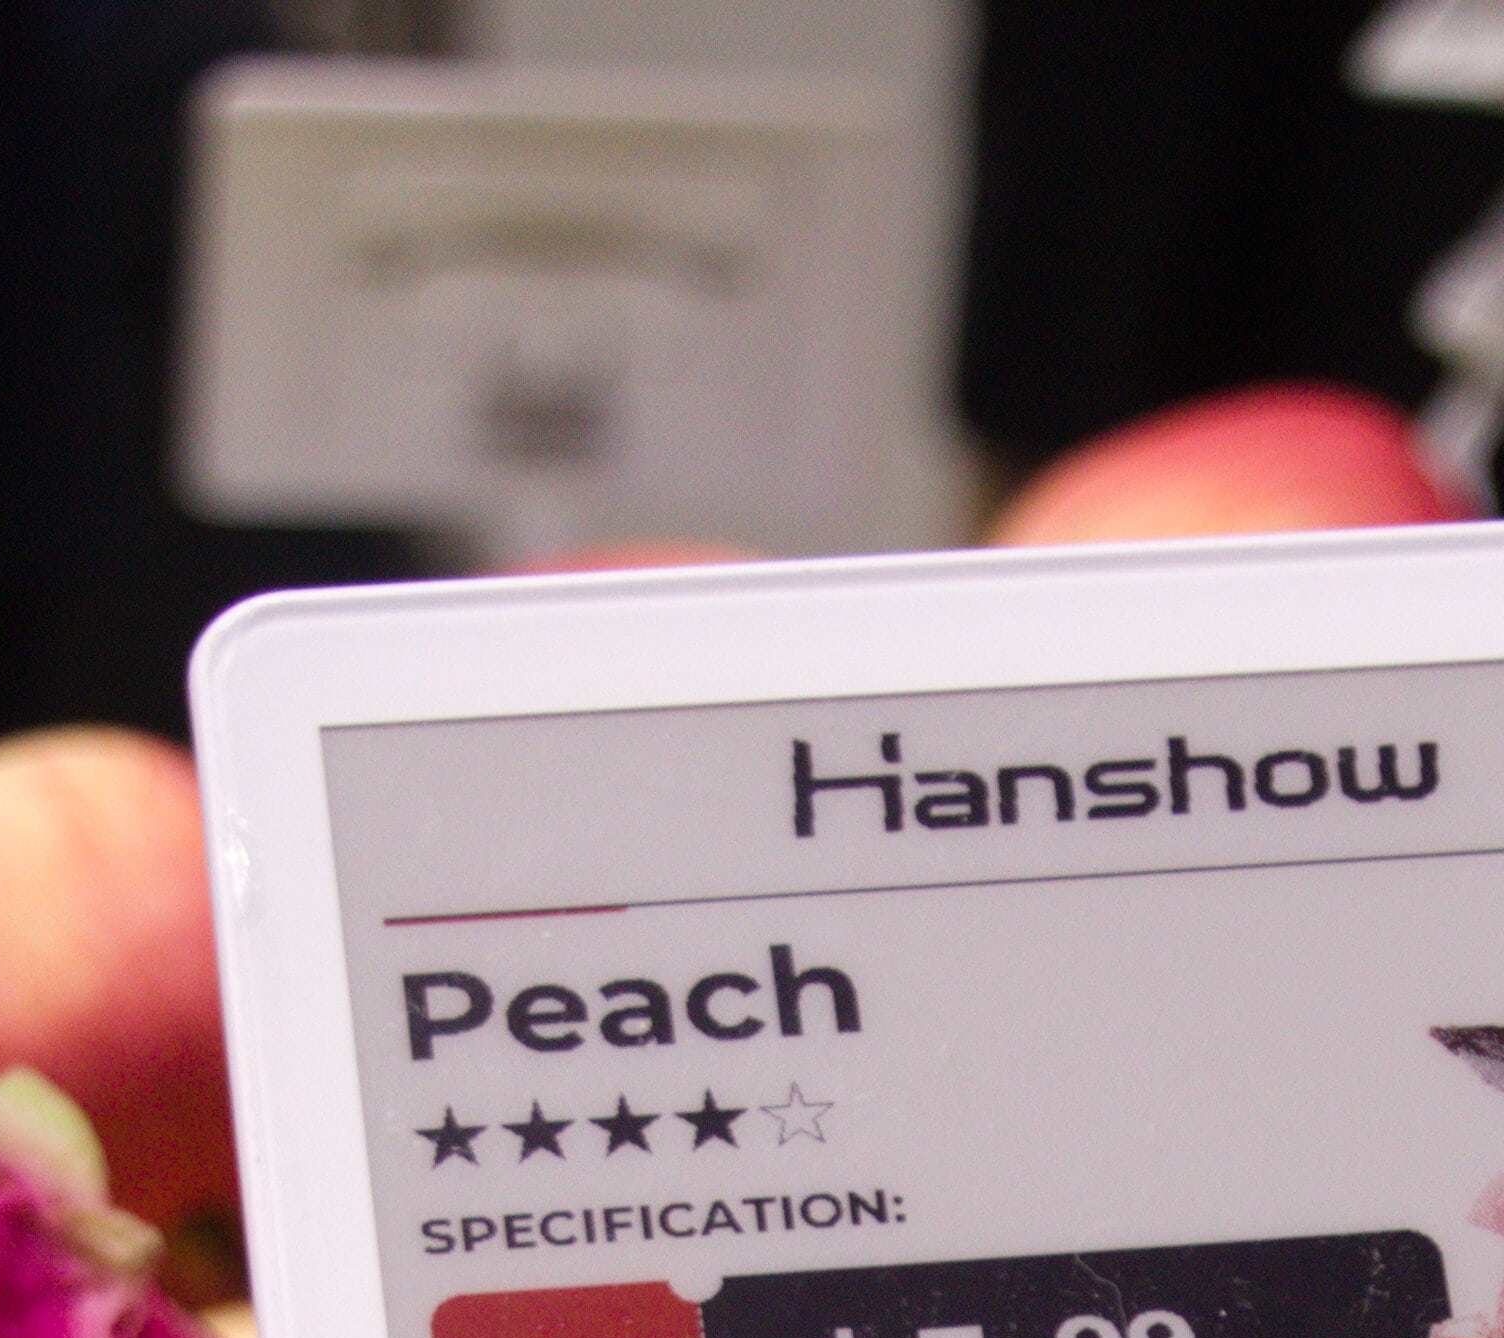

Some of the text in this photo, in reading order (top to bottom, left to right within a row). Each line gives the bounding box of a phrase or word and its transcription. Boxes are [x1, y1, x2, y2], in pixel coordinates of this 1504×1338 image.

[793, 733, 1438, 838] Hanshow
[402, 943, 862, 1060] Peach
[421, 1189, 907, 1254] SPECIFICATION:
